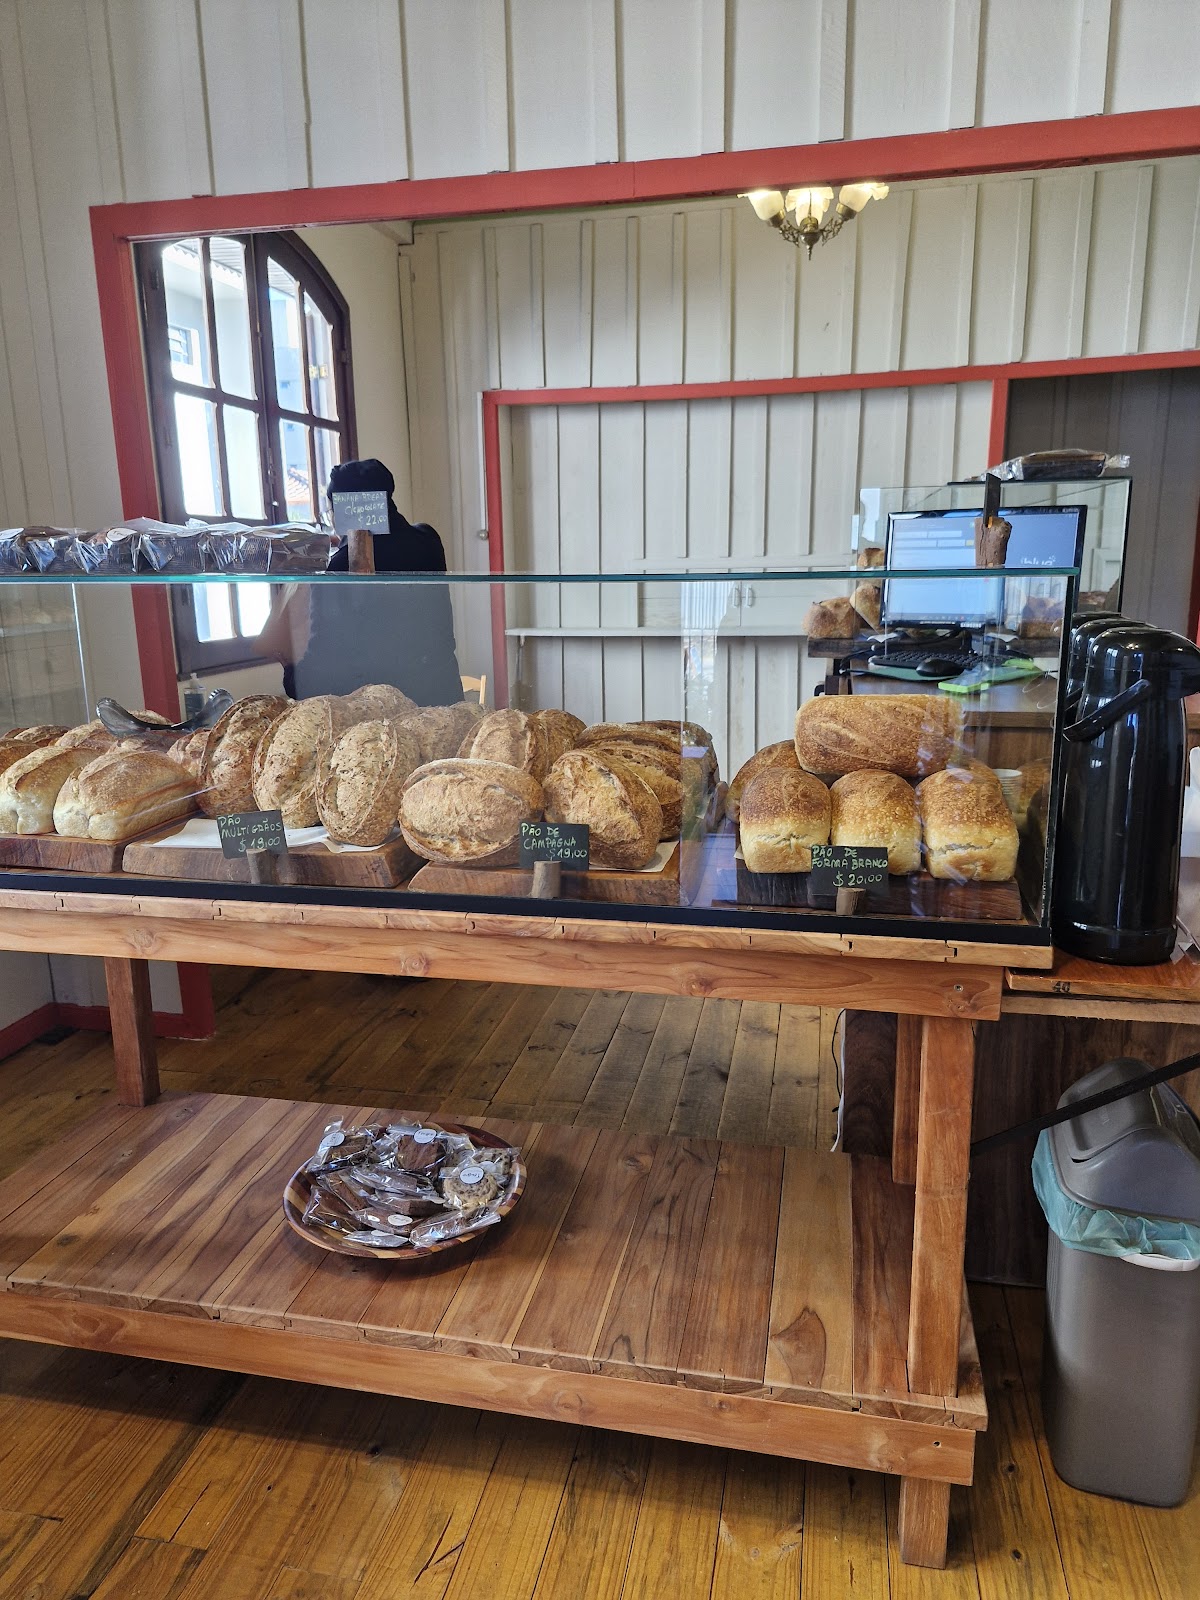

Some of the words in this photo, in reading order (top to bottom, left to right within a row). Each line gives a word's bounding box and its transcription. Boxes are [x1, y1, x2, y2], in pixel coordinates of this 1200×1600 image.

[217, 814, 241, 828] PÃO
[521, 822, 541, 836] PÃO
[547, 826, 559, 838] DE
[523, 836, 577, 850] CAMPAGNA
[811, 845, 833, 858] PÃO
[844, 847, 857, 858] DE
[811, 858, 849, 869] FORMA
[851, 858, 888, 870] BRANCO
[833, 871, 844, 887] $
